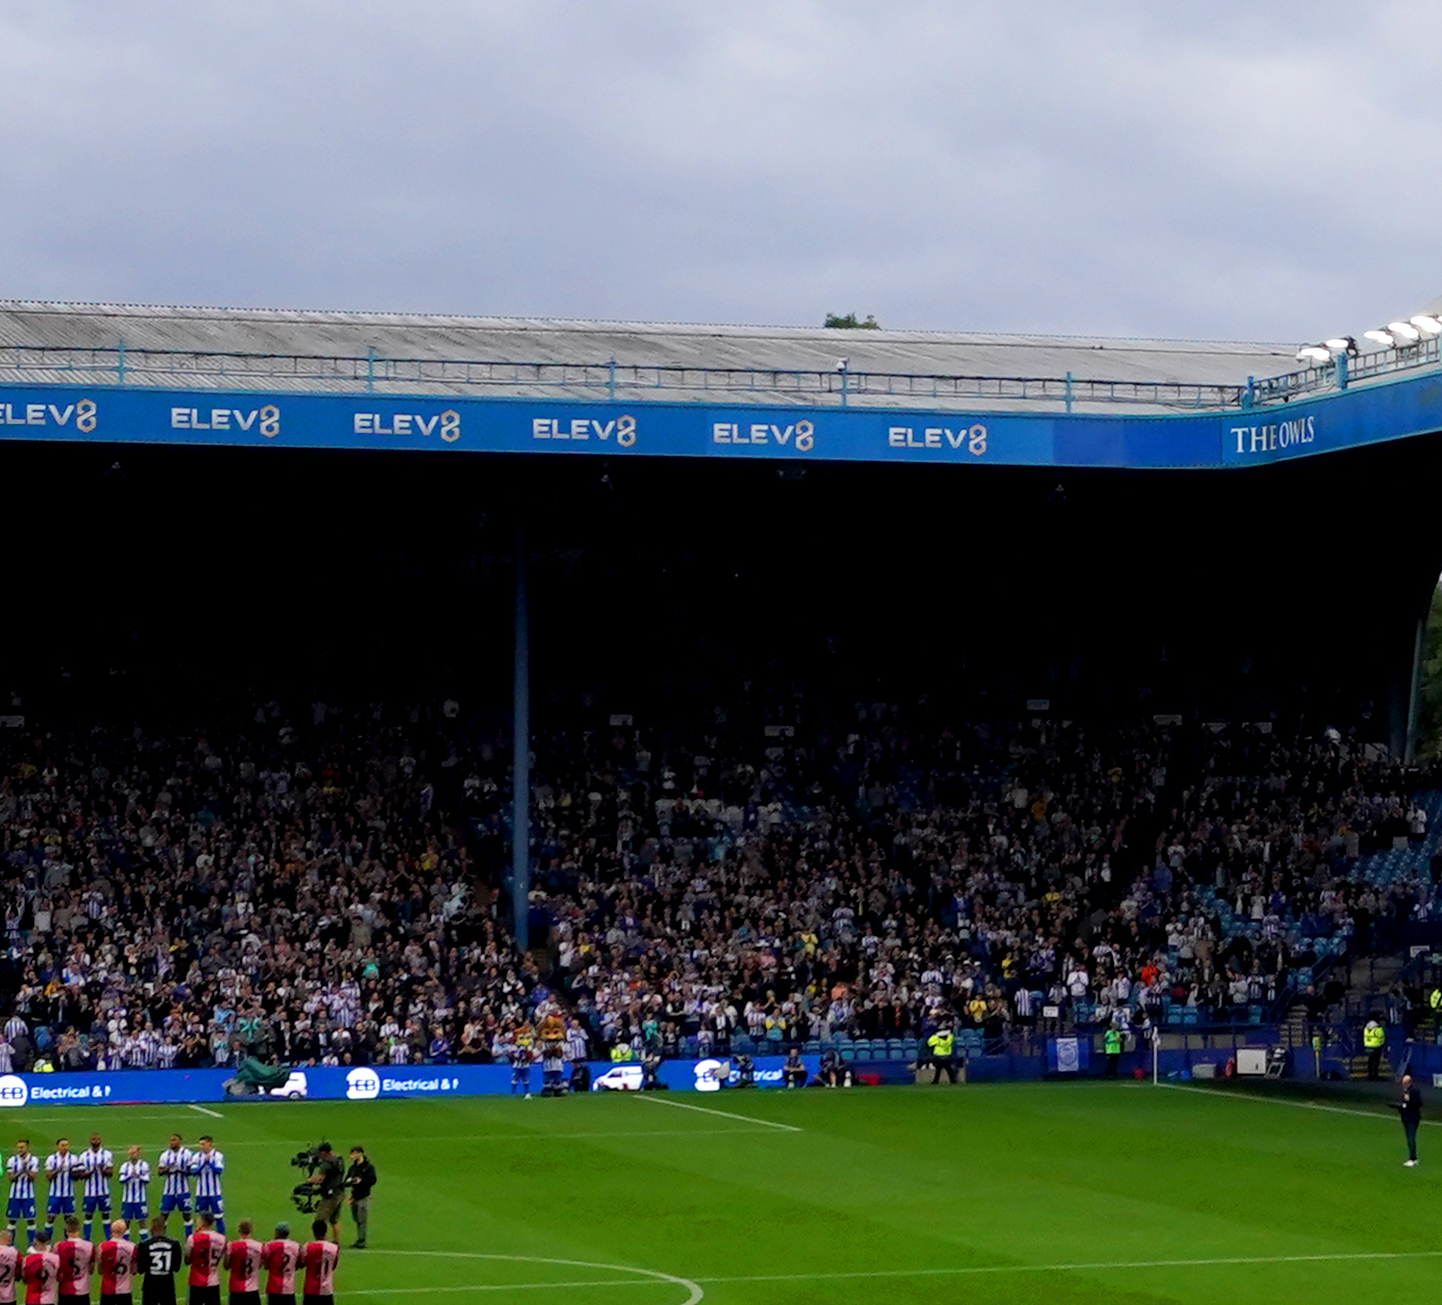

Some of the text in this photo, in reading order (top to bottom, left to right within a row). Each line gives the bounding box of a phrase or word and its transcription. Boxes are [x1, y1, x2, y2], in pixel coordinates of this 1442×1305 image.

[172, 405, 280, 438] ELEV8
[355, 410, 460, 443] ELEV8
[533, 414, 636, 447] ELEV8
[714, 419, 814, 452] ELEV8
[1230, 416, 1315, 453] THE OWLS
[888, 424, 987, 457] ELEV8
[31, 1086, 90, 1099] Electrical
[92, 1085, 103, 1098] &
[382, 1078, 439, 1091] Electrical
[440, 1078, 451, 1090] &
[148, 1251, 171, 1271] 31
